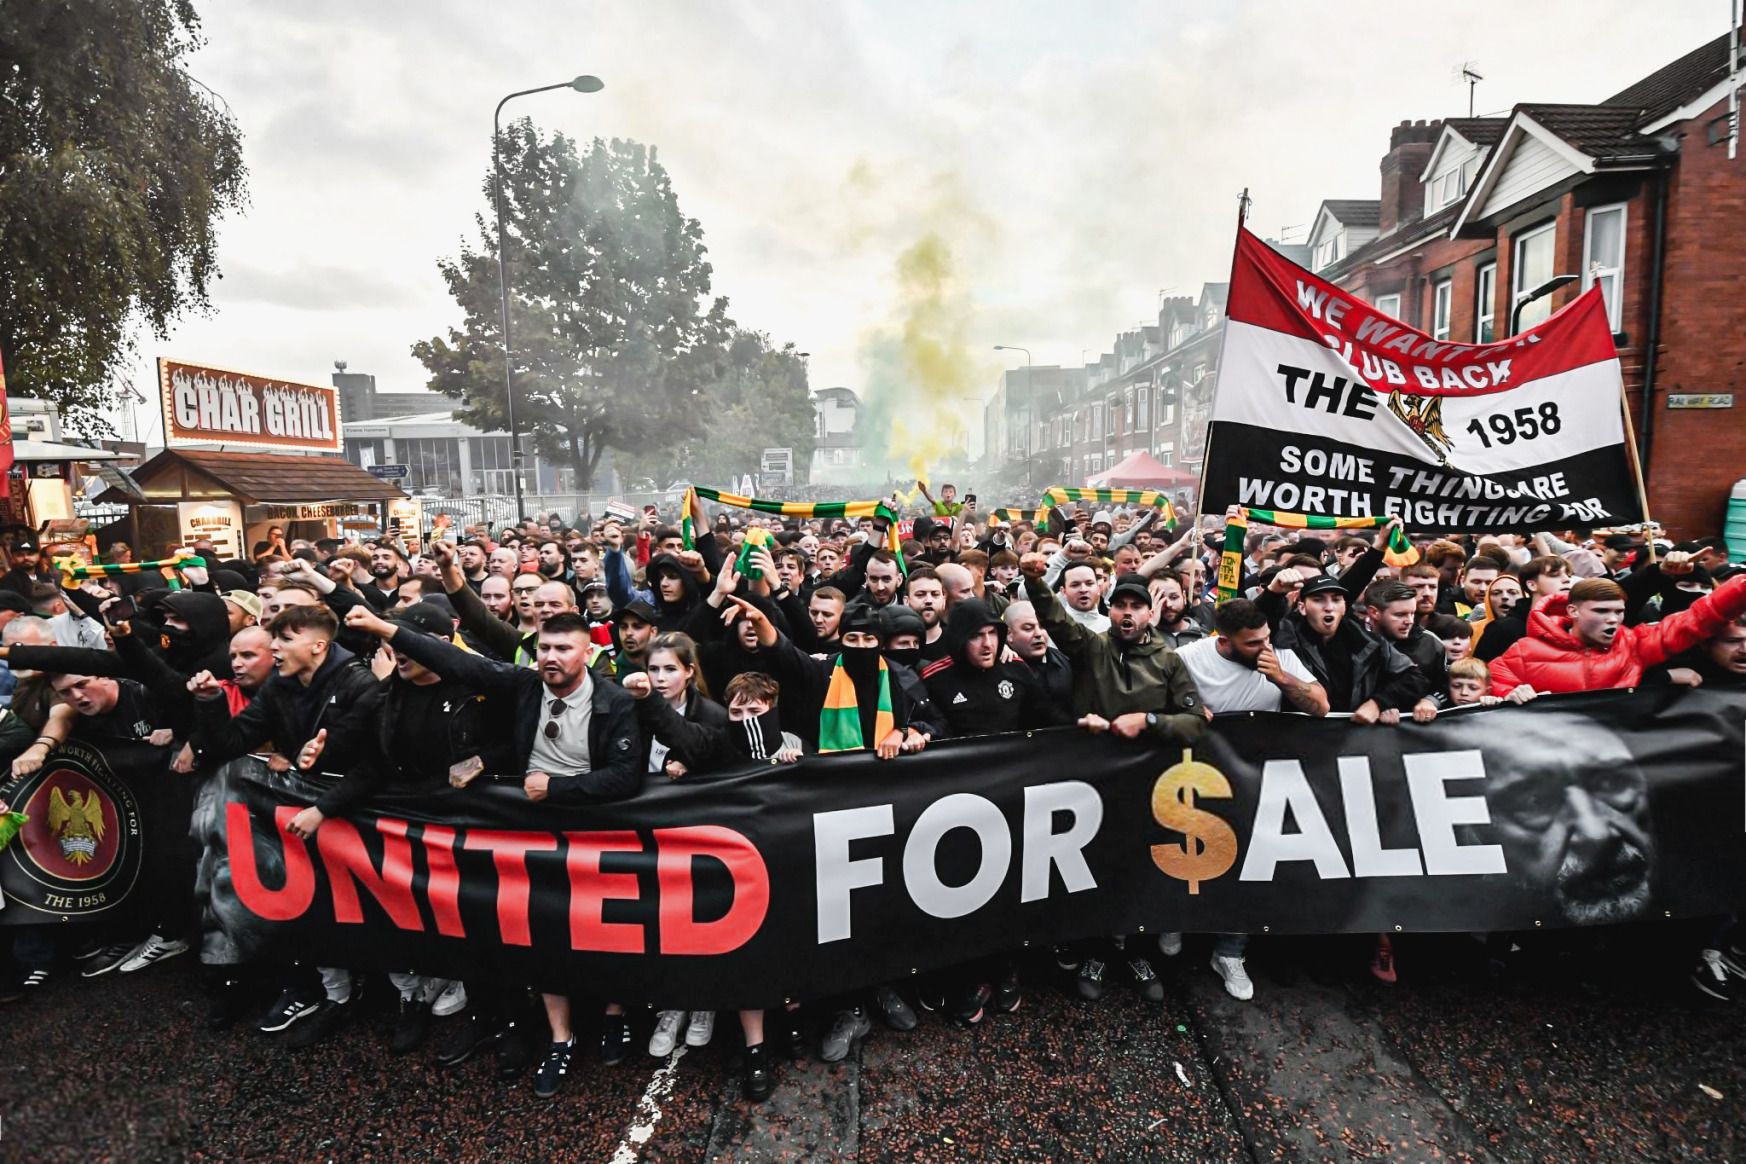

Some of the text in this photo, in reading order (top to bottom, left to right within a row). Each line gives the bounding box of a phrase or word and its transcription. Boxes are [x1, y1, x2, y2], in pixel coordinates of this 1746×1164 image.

[1296, 280, 1353, 330] WE
[1355, 315, 1476, 362] WANT
[1276, 363, 1379, 421] THE
[1413, 359, 1513, 390] BACK
[172, 385, 334, 441] CHAR GRILL
[1466, 401, 1561, 448] 1958
[1280, 445, 1375, 484] SOME
[1239, 477, 1613, 526] WORTH FIGHTING FOR
[59, 745, 92, 762] WORTH
[128, 812, 138, 836] FOR
[227, 748, 1508, 957] UNITED FOR $ALE
[44, 893, 106, 908] THE 1958
